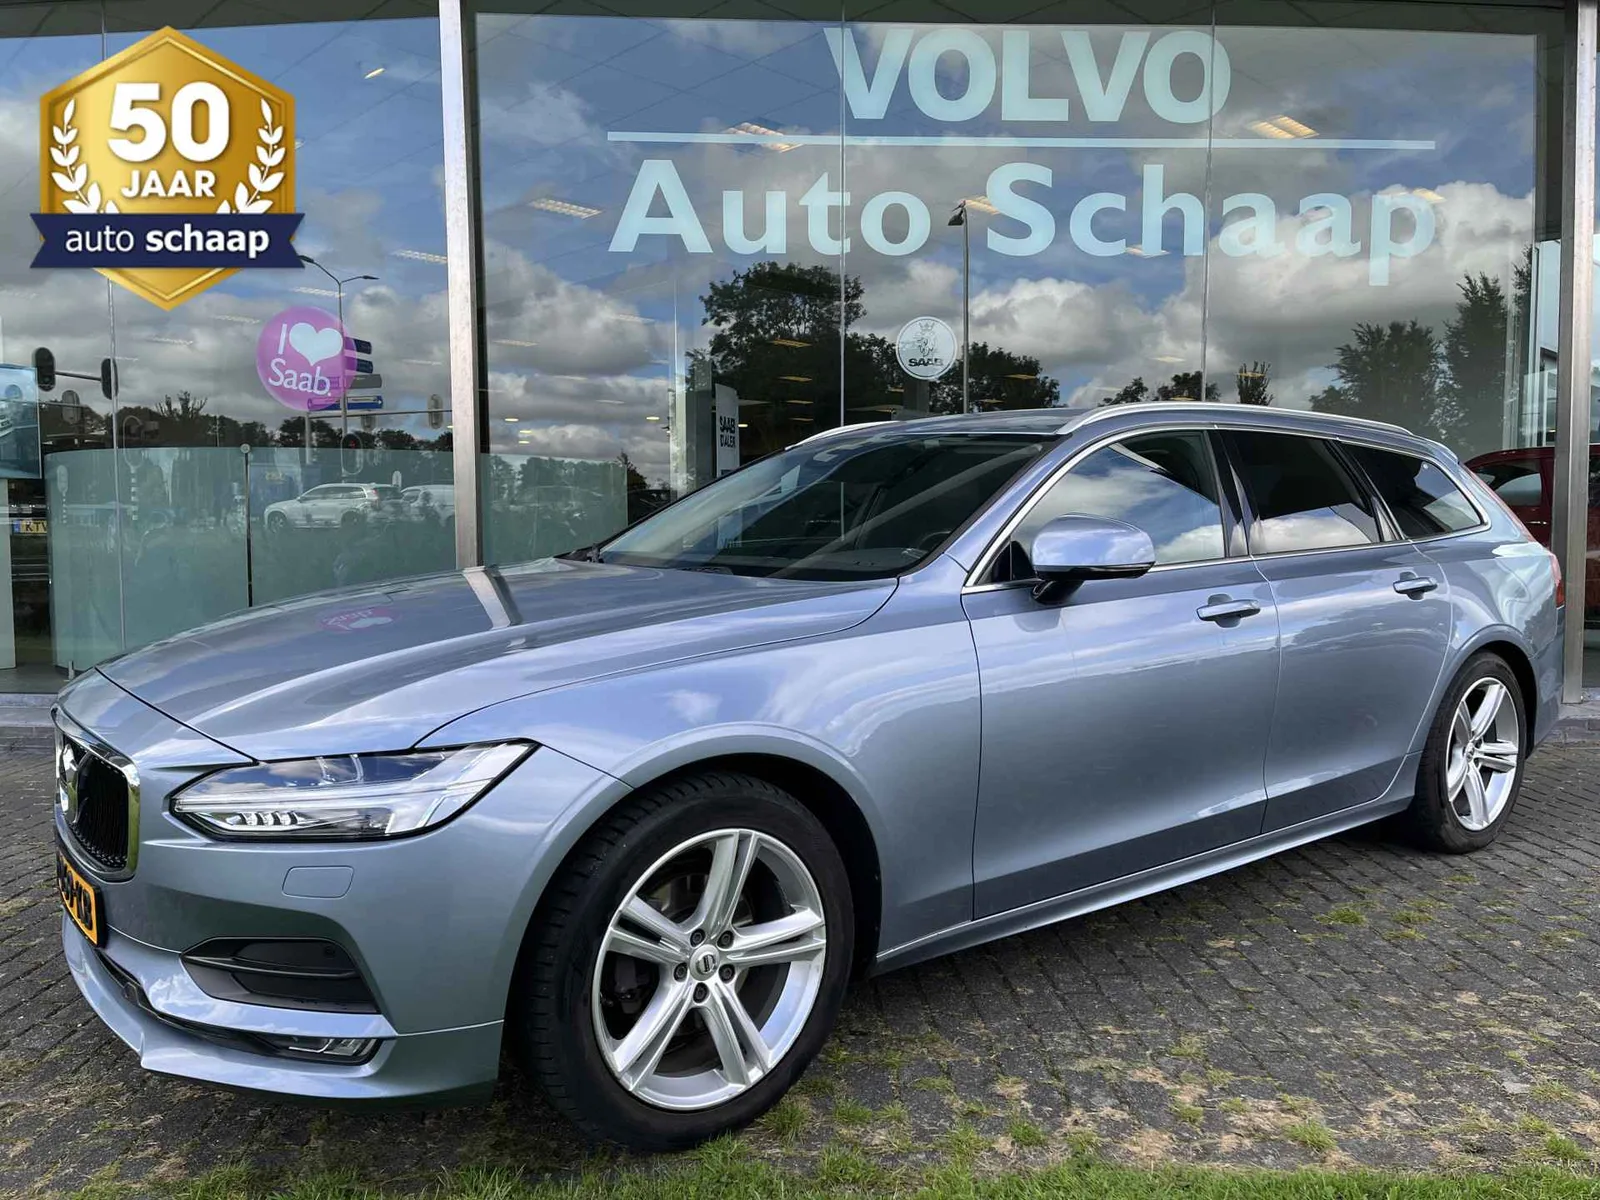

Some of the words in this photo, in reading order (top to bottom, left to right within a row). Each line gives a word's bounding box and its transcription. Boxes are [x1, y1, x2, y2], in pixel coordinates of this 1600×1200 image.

[823, 27, 1231, 124] VOLVO
[608, 159, 931, 257] Auto
[986, 162, 1436, 287] Schaap
[278, 324, 288, 355] I
